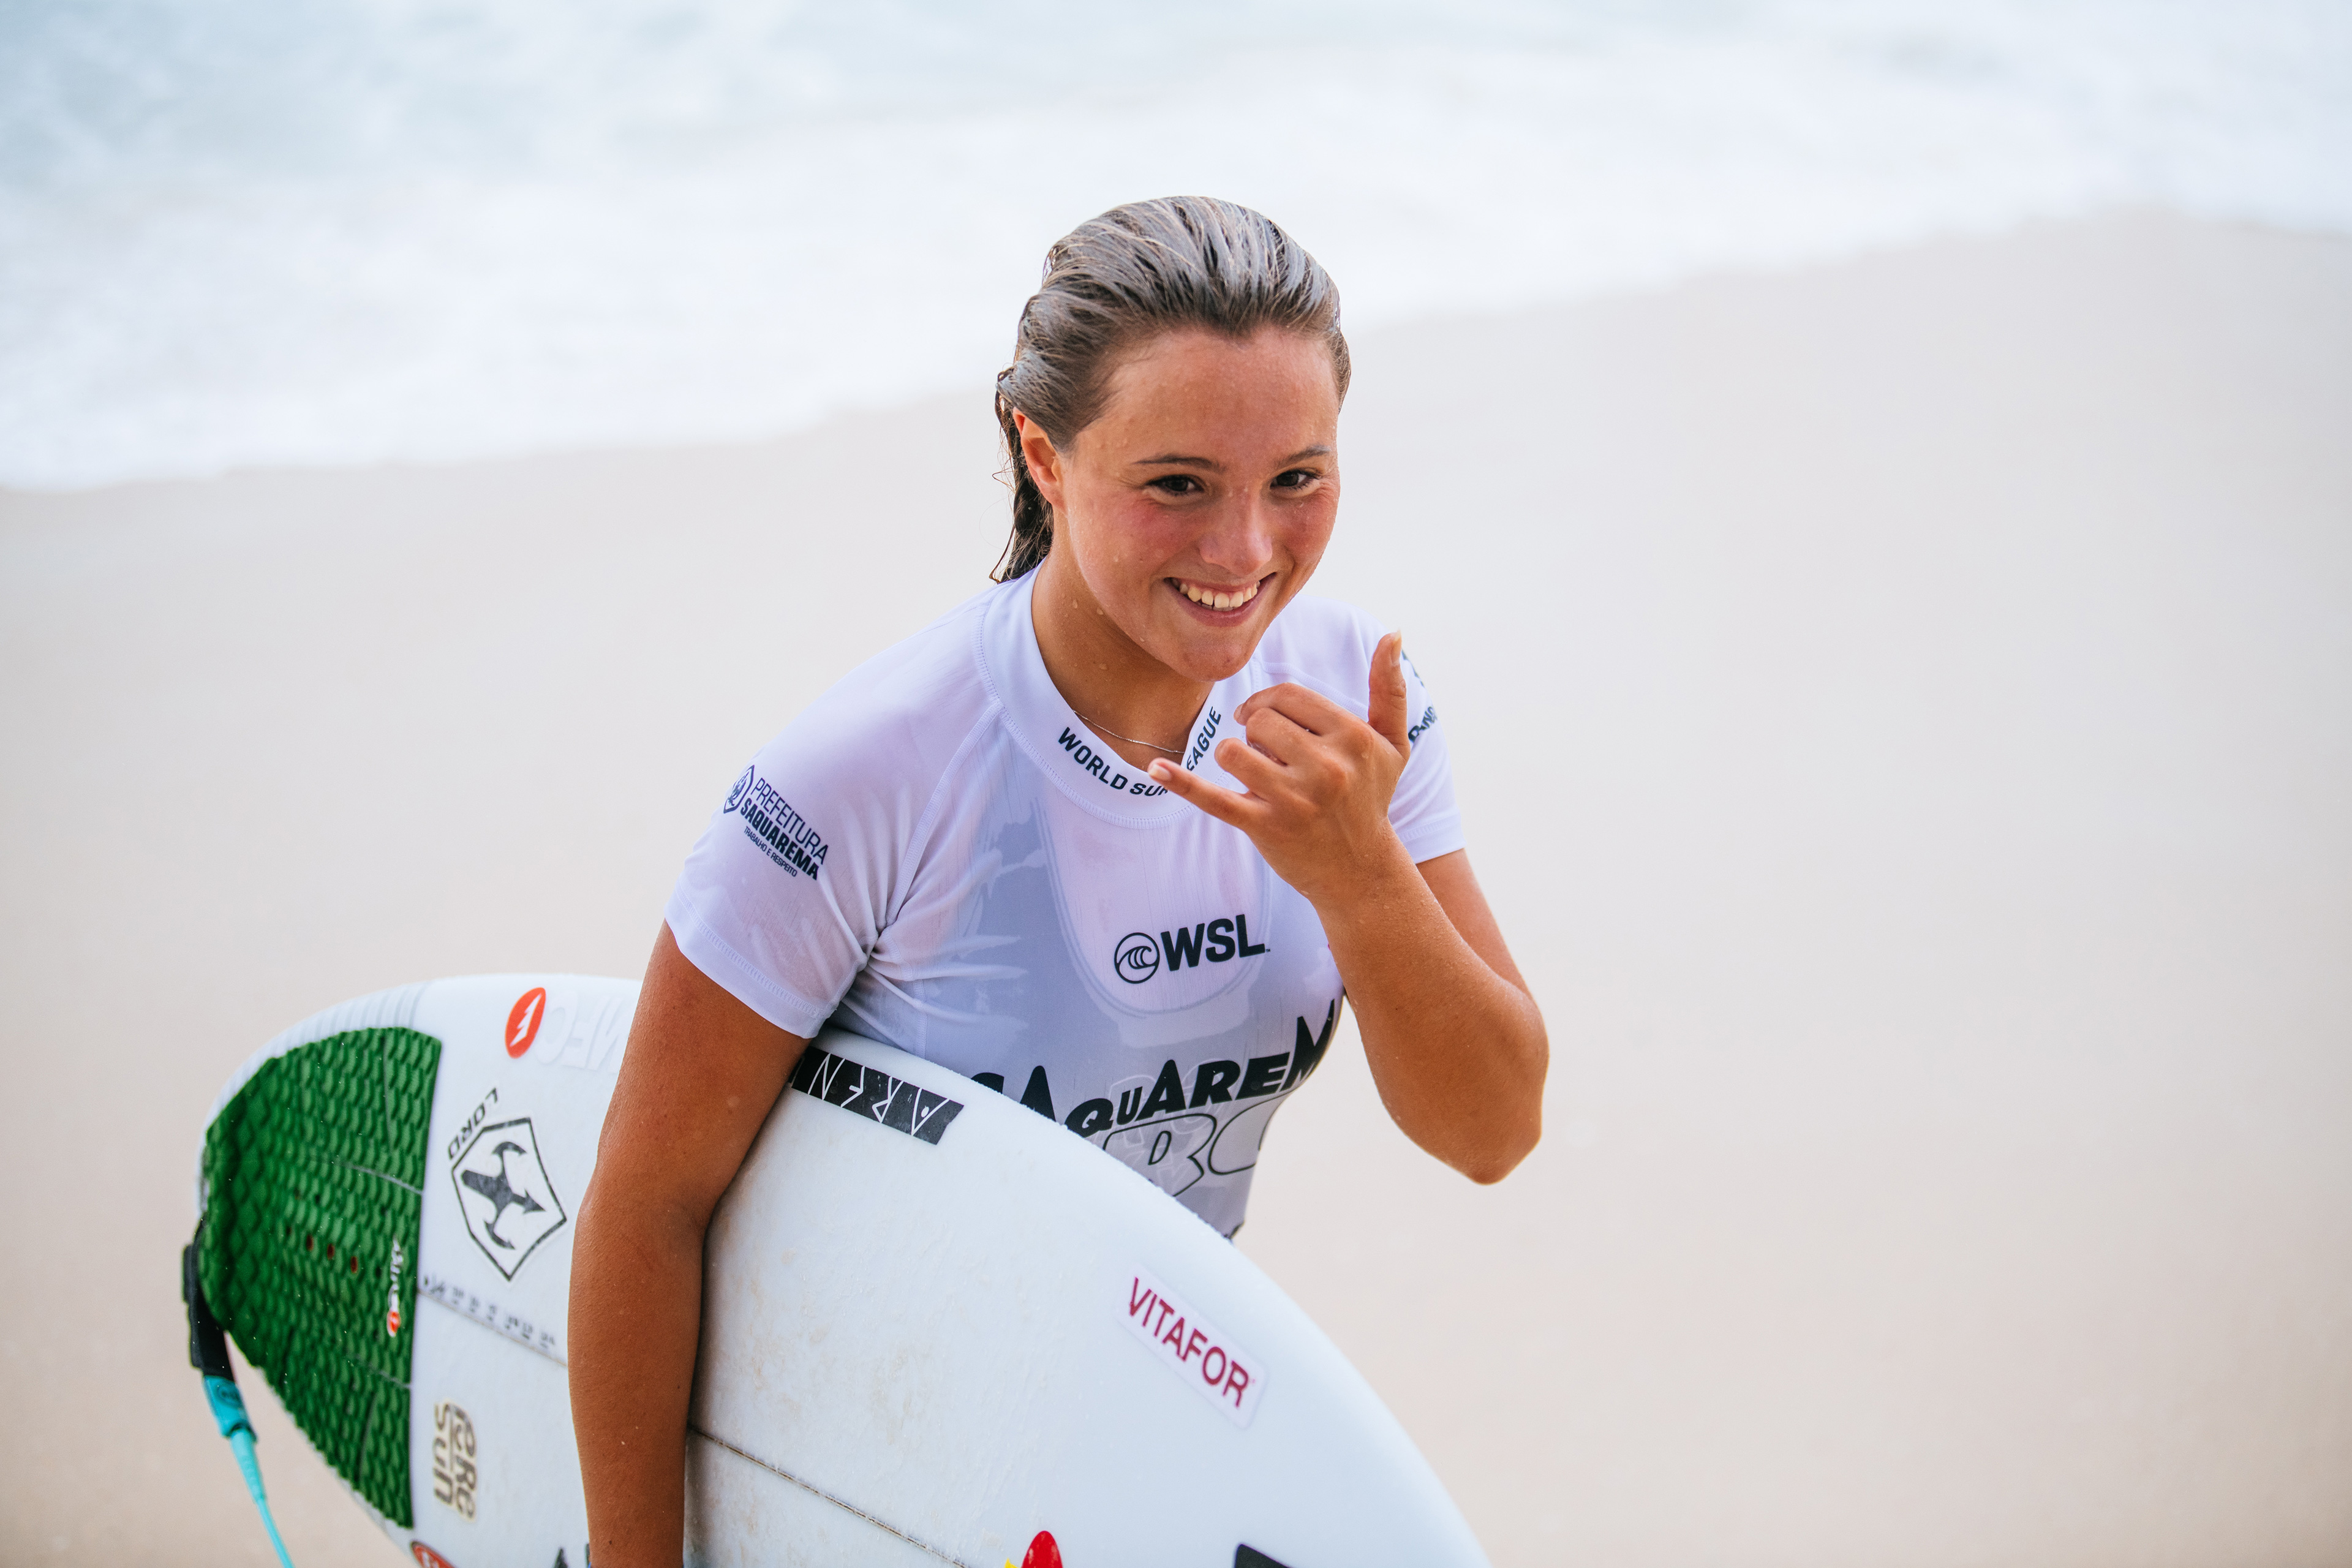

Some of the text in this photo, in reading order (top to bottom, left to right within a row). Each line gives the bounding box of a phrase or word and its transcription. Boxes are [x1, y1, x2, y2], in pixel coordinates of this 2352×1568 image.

[1058, 706, 1221, 796] WORLD SU EAGUE
[740, 797, 820, 881] SAQUAREMA
[744, 826, 767, 856] TRABALHO
[771, 852, 798, 877] RESPEITO
[750, 777, 828, 865] PREFEITURA
[1160, 914, 1266, 971] WSL
[970, 998, 1335, 1138] AQUAREM
[448, 1087, 499, 1161] LORD
[1129, 1276, 1250, 1409] VITAFOR
